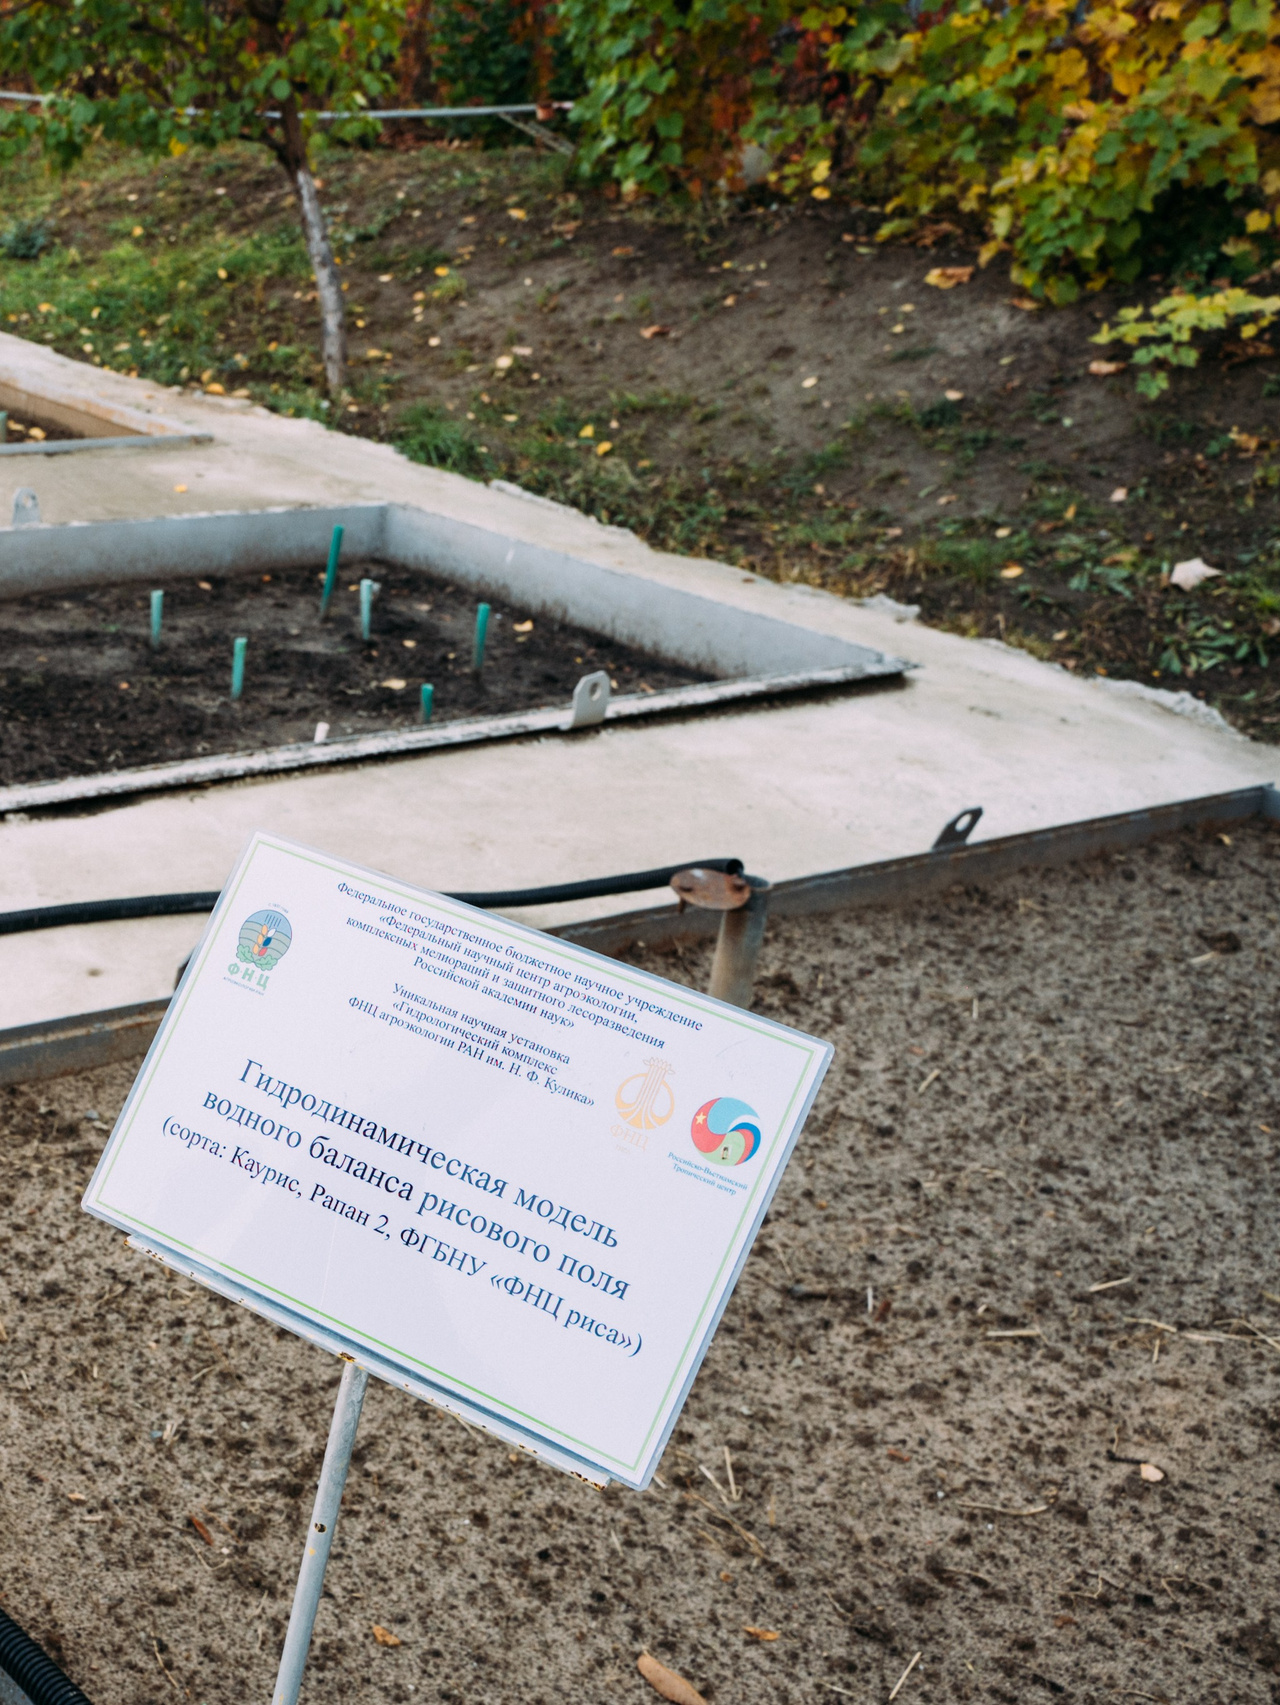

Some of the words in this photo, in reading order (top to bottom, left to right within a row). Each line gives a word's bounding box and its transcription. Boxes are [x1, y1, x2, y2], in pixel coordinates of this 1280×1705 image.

[337, 882, 408, 917] Федеральное
[408, 911, 504, 953] государственное
[504, 945, 572, 980] бюджетное
[573, 974, 625, 1001] научное
[624, 994, 703, 1032] учреждение
[346, 917, 419, 952] комплексных
[419, 945, 491, 980] мелиораций
[491, 973, 501, 984] и
[502, 977, 566, 1009] защитного
[566, 1004, 666, 1050] лесоразведения
[379, 915, 462, 953] «Федеральный
[462, 947, 515, 973] научный
[515, 967, 552, 989] центр
[552, 982, 639, 1024] агроэкологии,
[413, 955, 481, 991] Российской
[480, 985, 538, 1015] академии
[539, 1008, 575, 1028] наук»
[348, 996, 379, 1018] ФНЦ
[378, 1011, 456, 1049] агроэкологии
[456, 1040, 485, 1061] РАН
[485, 1055, 505, 1071] им.
[508, 1061, 522, 1078] Н.
[526, 1070, 540, 1085] Ф.
[543, 1076, 595, 1106] Кулика»
[392, 982, 459, 1019] Уникальная
[460, 1013, 508, 1039] научная
[507, 1033, 571, 1065] установка
[392, 1000, 501, 1052] «Гидрологический
[500, 1042, 558, 1076] комплекс
[238, 1058, 509, 1199] Гидродинамическая
[512, 1187, 618, 1248] модель
[609, 1124, 649, 1153] ФНЦ
[672, 1162, 716, 1187] Тропический
[715, 1183, 737, 1197] центр
[162, 1115, 227, 1159] (сорта:
[229, 1145, 302, 1199] Каурис,
[308, 1182, 371, 1227] Рапан
[372, 1213, 391, 1241] 2,
[399, 1226, 488, 1277] ФГБНУ
[489, 1274, 565, 1322] «ФНЦ
[562, 1309, 643, 1358] риса»)
[202, 1091, 302, 1149] водного
[308, 1135, 414, 1202] баланса
[415, 1191, 551, 1263] рисового
[556, 1253, 631, 1301] поля
